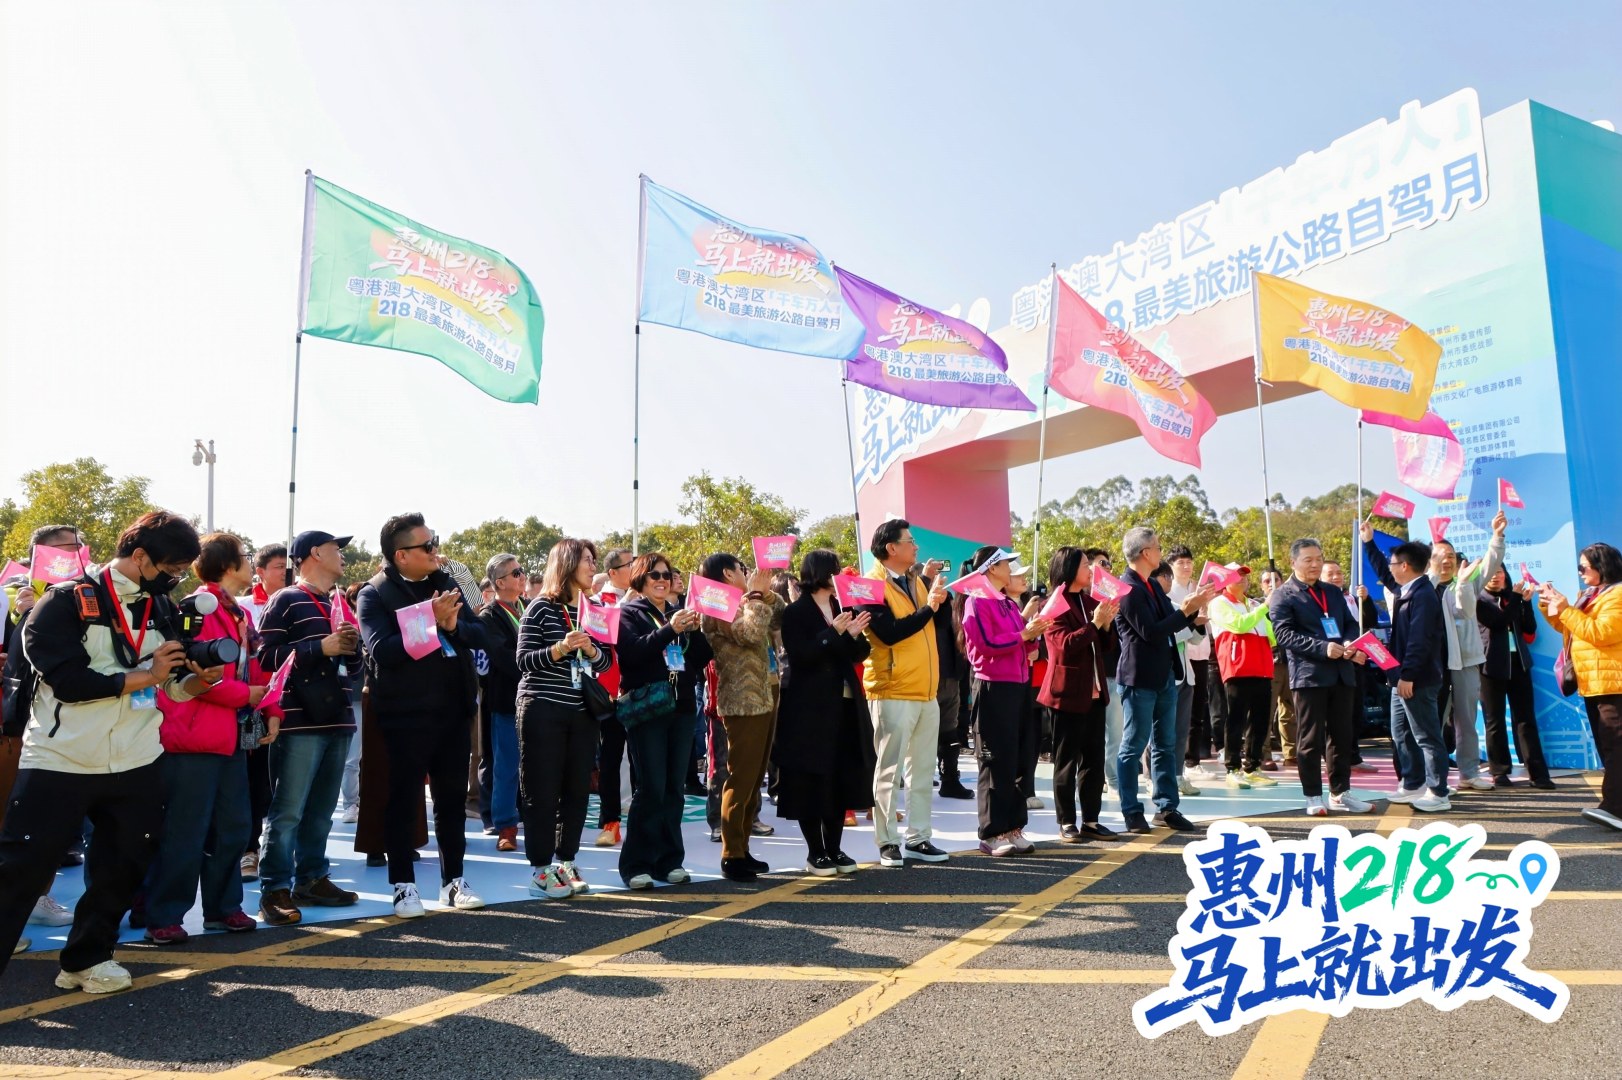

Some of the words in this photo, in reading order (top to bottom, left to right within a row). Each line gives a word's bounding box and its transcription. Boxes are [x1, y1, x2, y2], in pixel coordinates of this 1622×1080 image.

[369, 244, 513, 334] 马上就出发
[694, 244, 831, 295] 马上就出发
[1304, 297, 1390, 328] 惠州218
[877, 317, 980, 350] 马上就
[1299, 319, 1406, 364] 马上就出发
[1438, 355, 1478, 371] 市大湾区办
